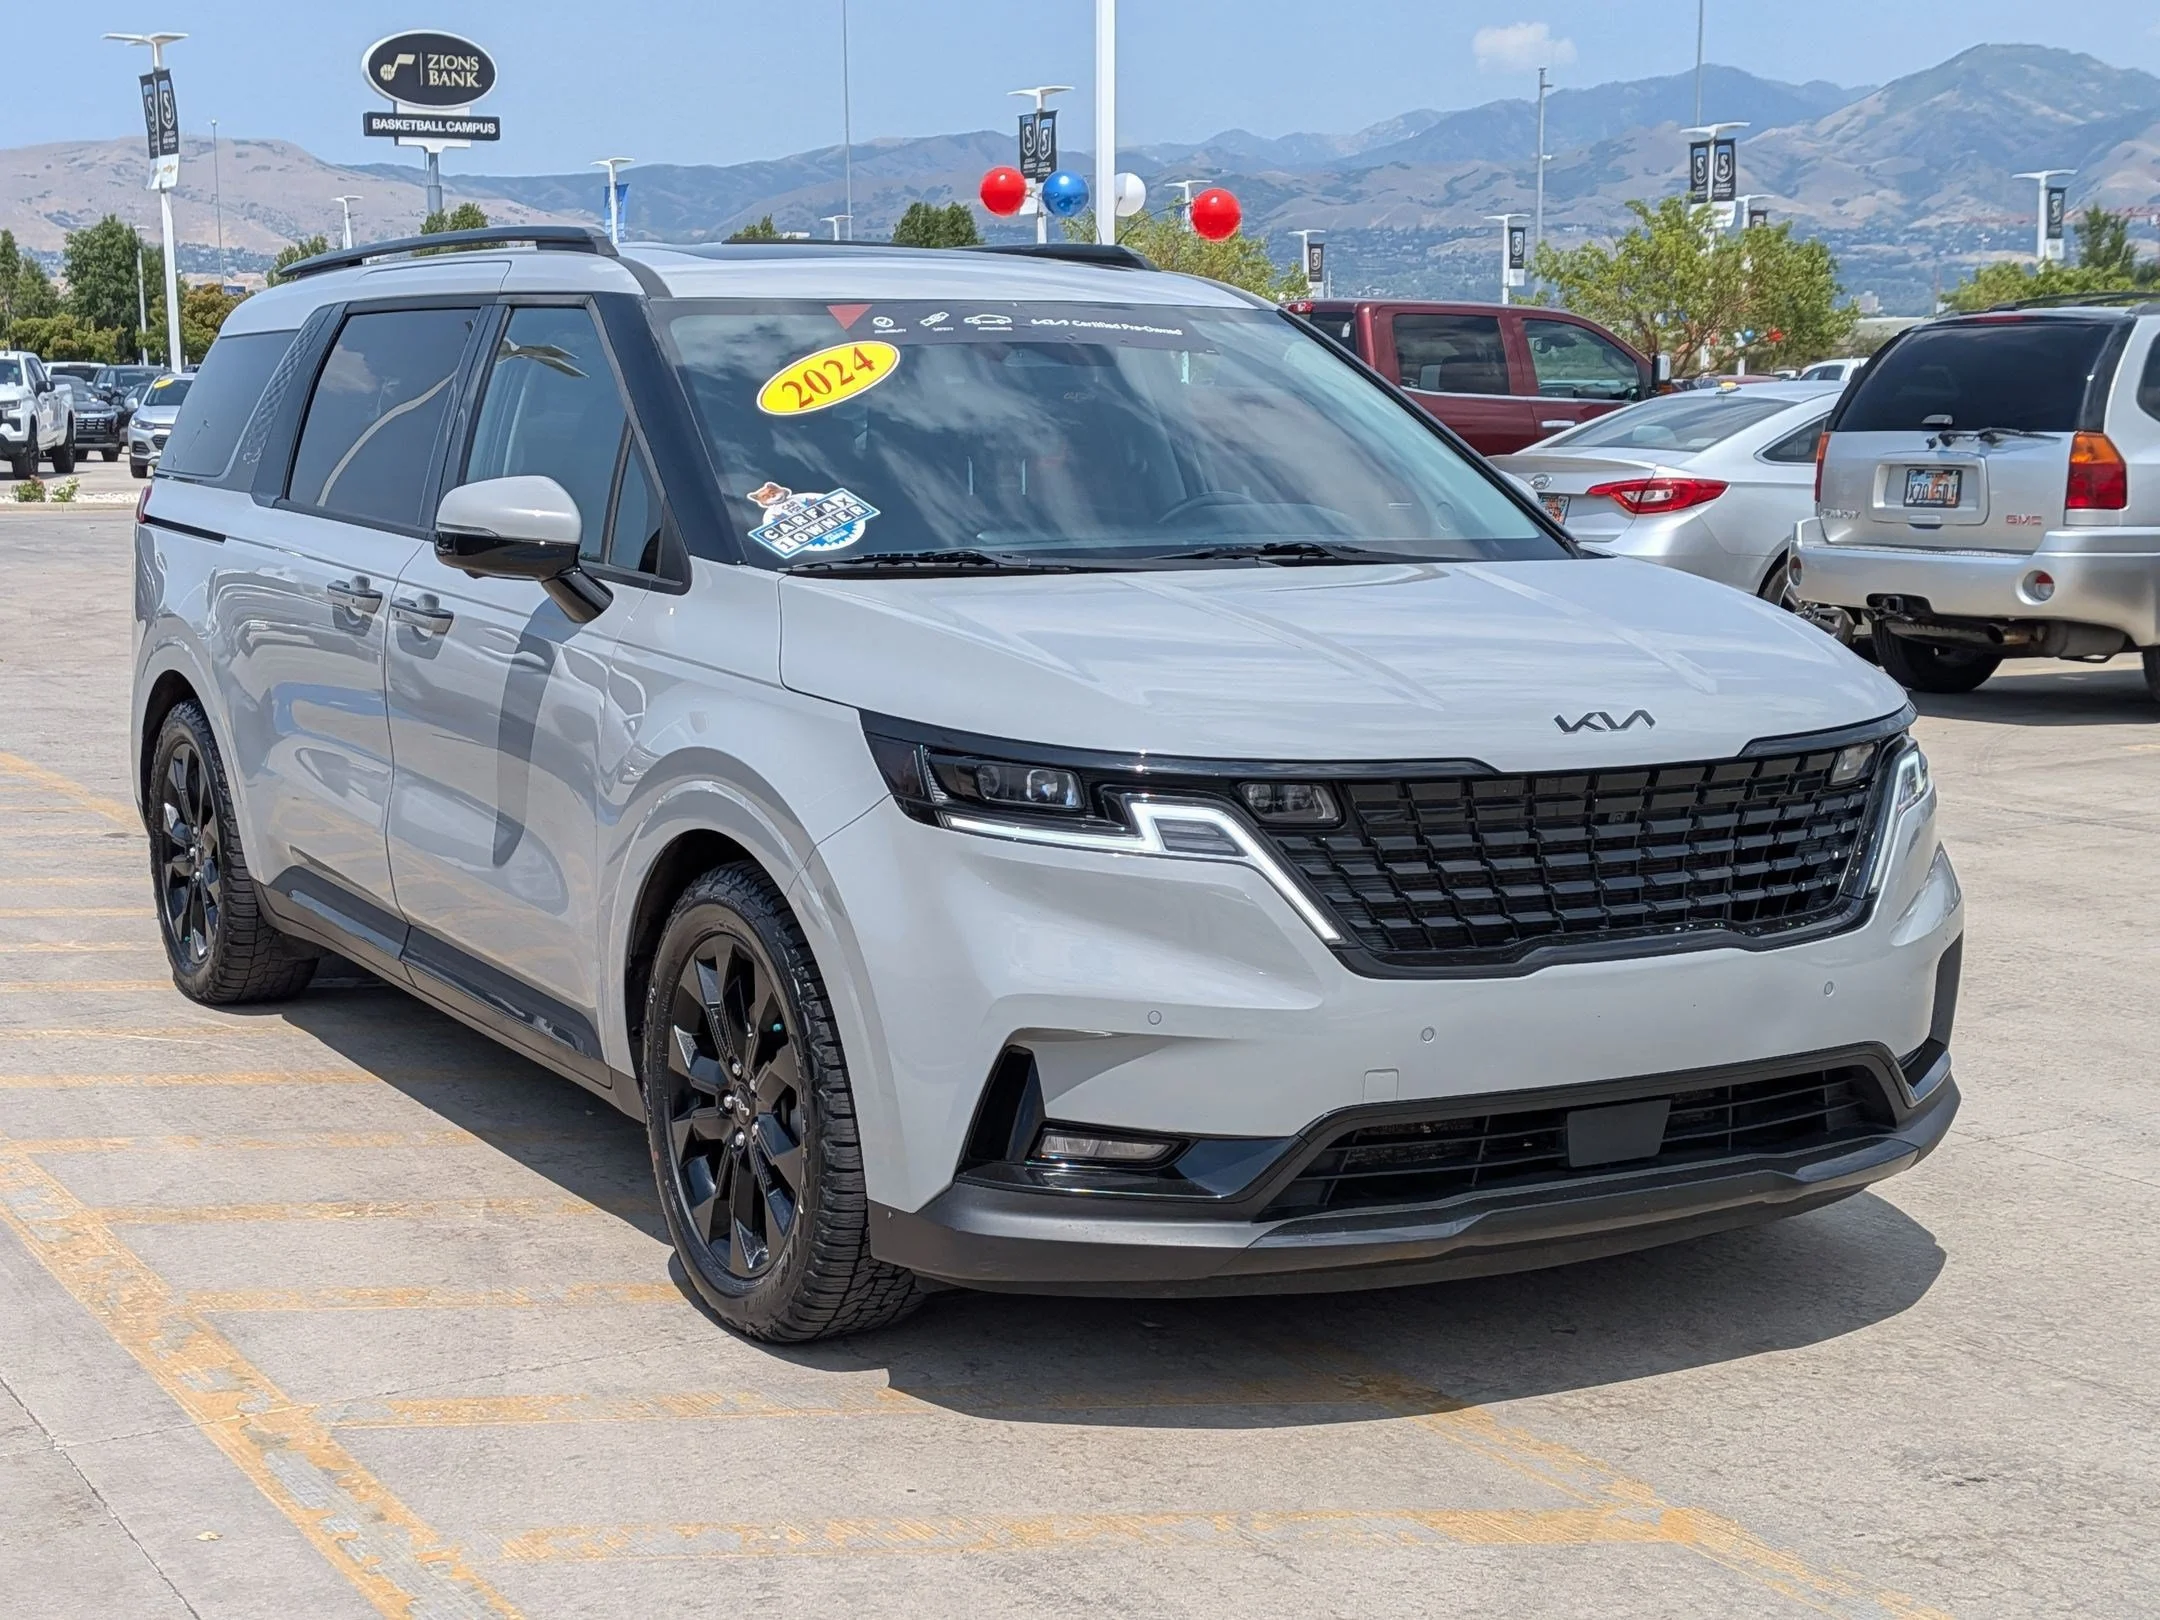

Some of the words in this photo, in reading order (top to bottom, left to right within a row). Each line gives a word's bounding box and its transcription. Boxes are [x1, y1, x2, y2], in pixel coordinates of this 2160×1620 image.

[427, 54, 479, 71] ZIONS
[372, 118, 445, 131] BASKETBALL
[446, 121, 496, 134] CAMPUS
[1072, 320, 1121, 330] Certified
[781, 346, 876, 408] 2024
[763, 497, 851, 540] CARFAX
[793, 505, 866, 541] OWNER
[2006, 514, 2042, 526] GMC
